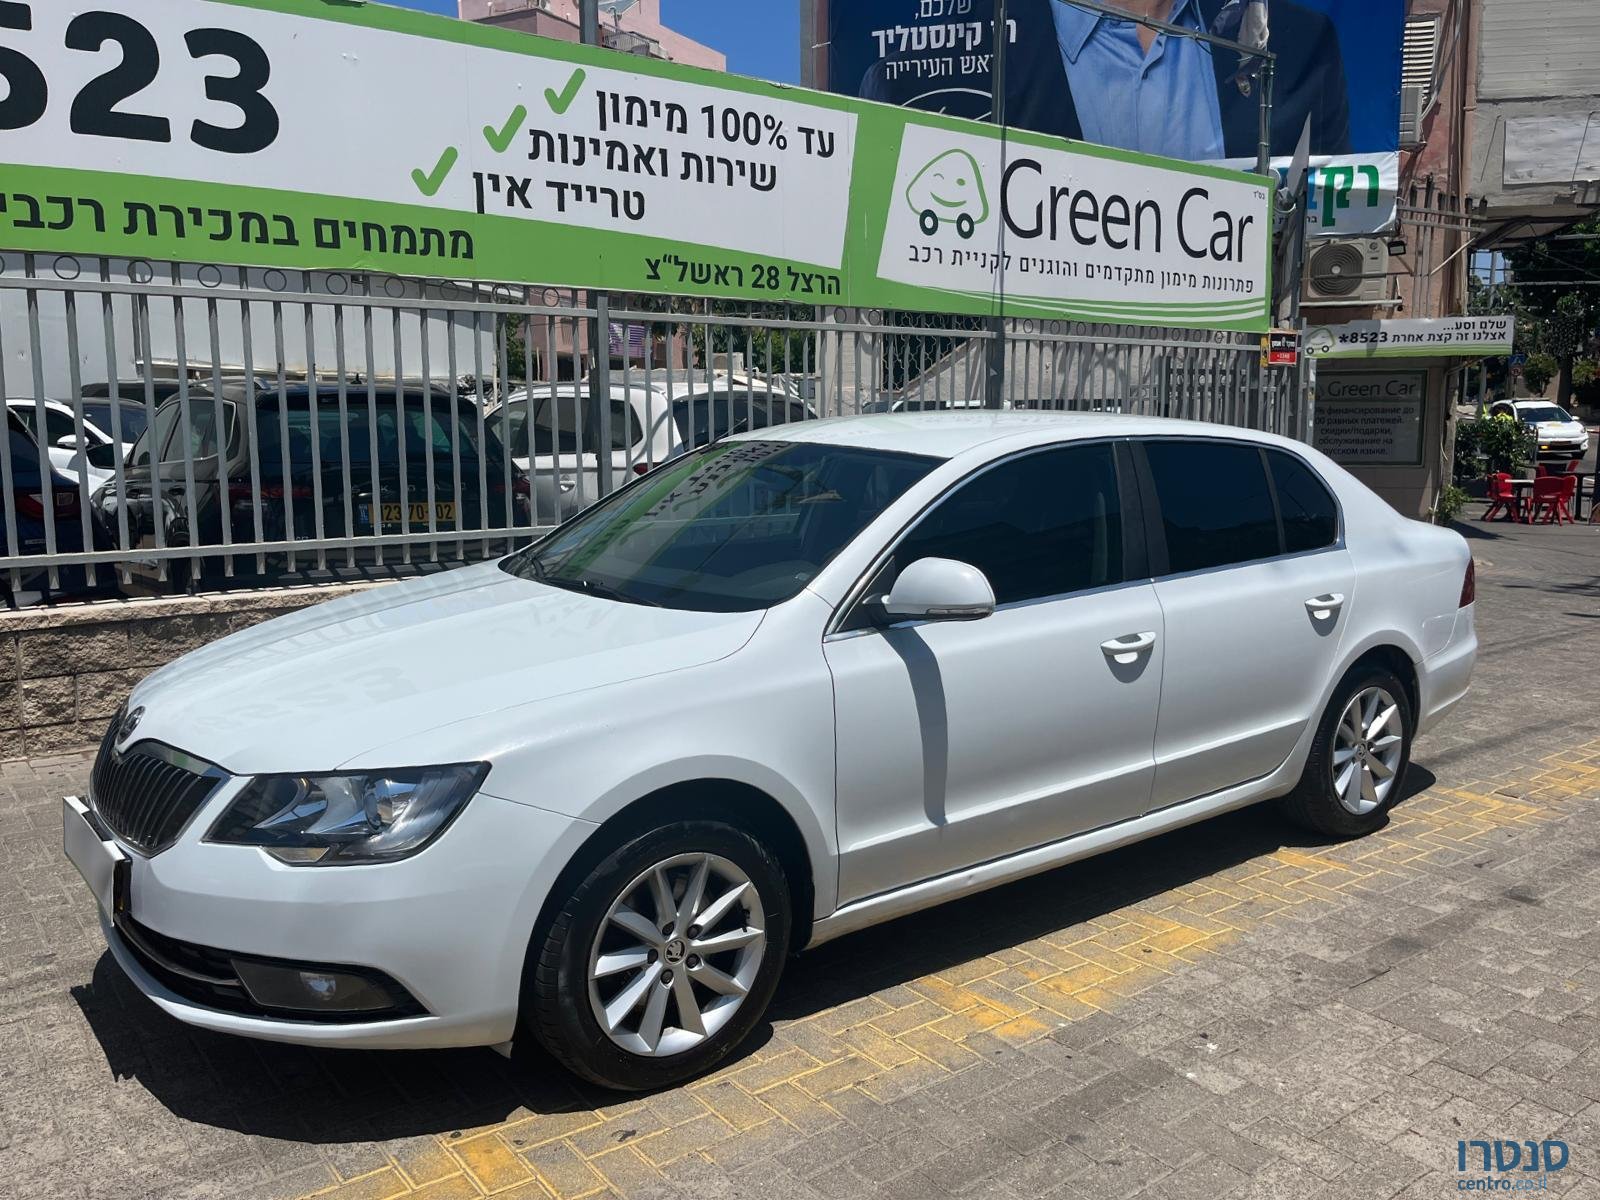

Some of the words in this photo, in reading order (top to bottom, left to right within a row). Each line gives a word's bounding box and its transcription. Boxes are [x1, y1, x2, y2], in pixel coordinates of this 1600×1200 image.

[871, 22, 982, 58] קינסטליך
[886, 58, 953, 80] העירייה
[960, 54, 994, 75] אש
[595, 89, 688, 135] מימון
[701, 104, 788, 151] 100%
[528, 128, 669, 177] ואמינות
[797, 125, 836, 158] עד
[680, 152, 777, 192] שירות
[472, 170, 533, 214] אין
[545, 180, 646, 220] טרייד
[123, 200, 300, 247] במכירת
[1000, 158, 1162, 253] Green
[1176, 187, 1254, 263] Car
[313, 218, 474, 260] מתמחים
[908, 244, 944, 265] רכב
[951, 249, 1012, 275] לקניית
[1019, 256, 1078, 278] והוגנים
[752, 263, 780, 291] 28
[787, 265, 841, 296] הרצל
[1085, 262, 1155, 287] מתקדמים
[1160, 270, 1197, 290] מימון
[1202, 275, 1254, 294] פתרונות
[1391, 333, 1424, 343] אחרת
[1456, 332, 1470, 341] זה
[1472, 331, 1506, 341] אצלנו
[1479, 320, 1507, 330] שלם
[1426, 333, 1452, 344] קצת
[1327, 381, 1380, 397] Green
[1385, 380, 1417, 396] Car
